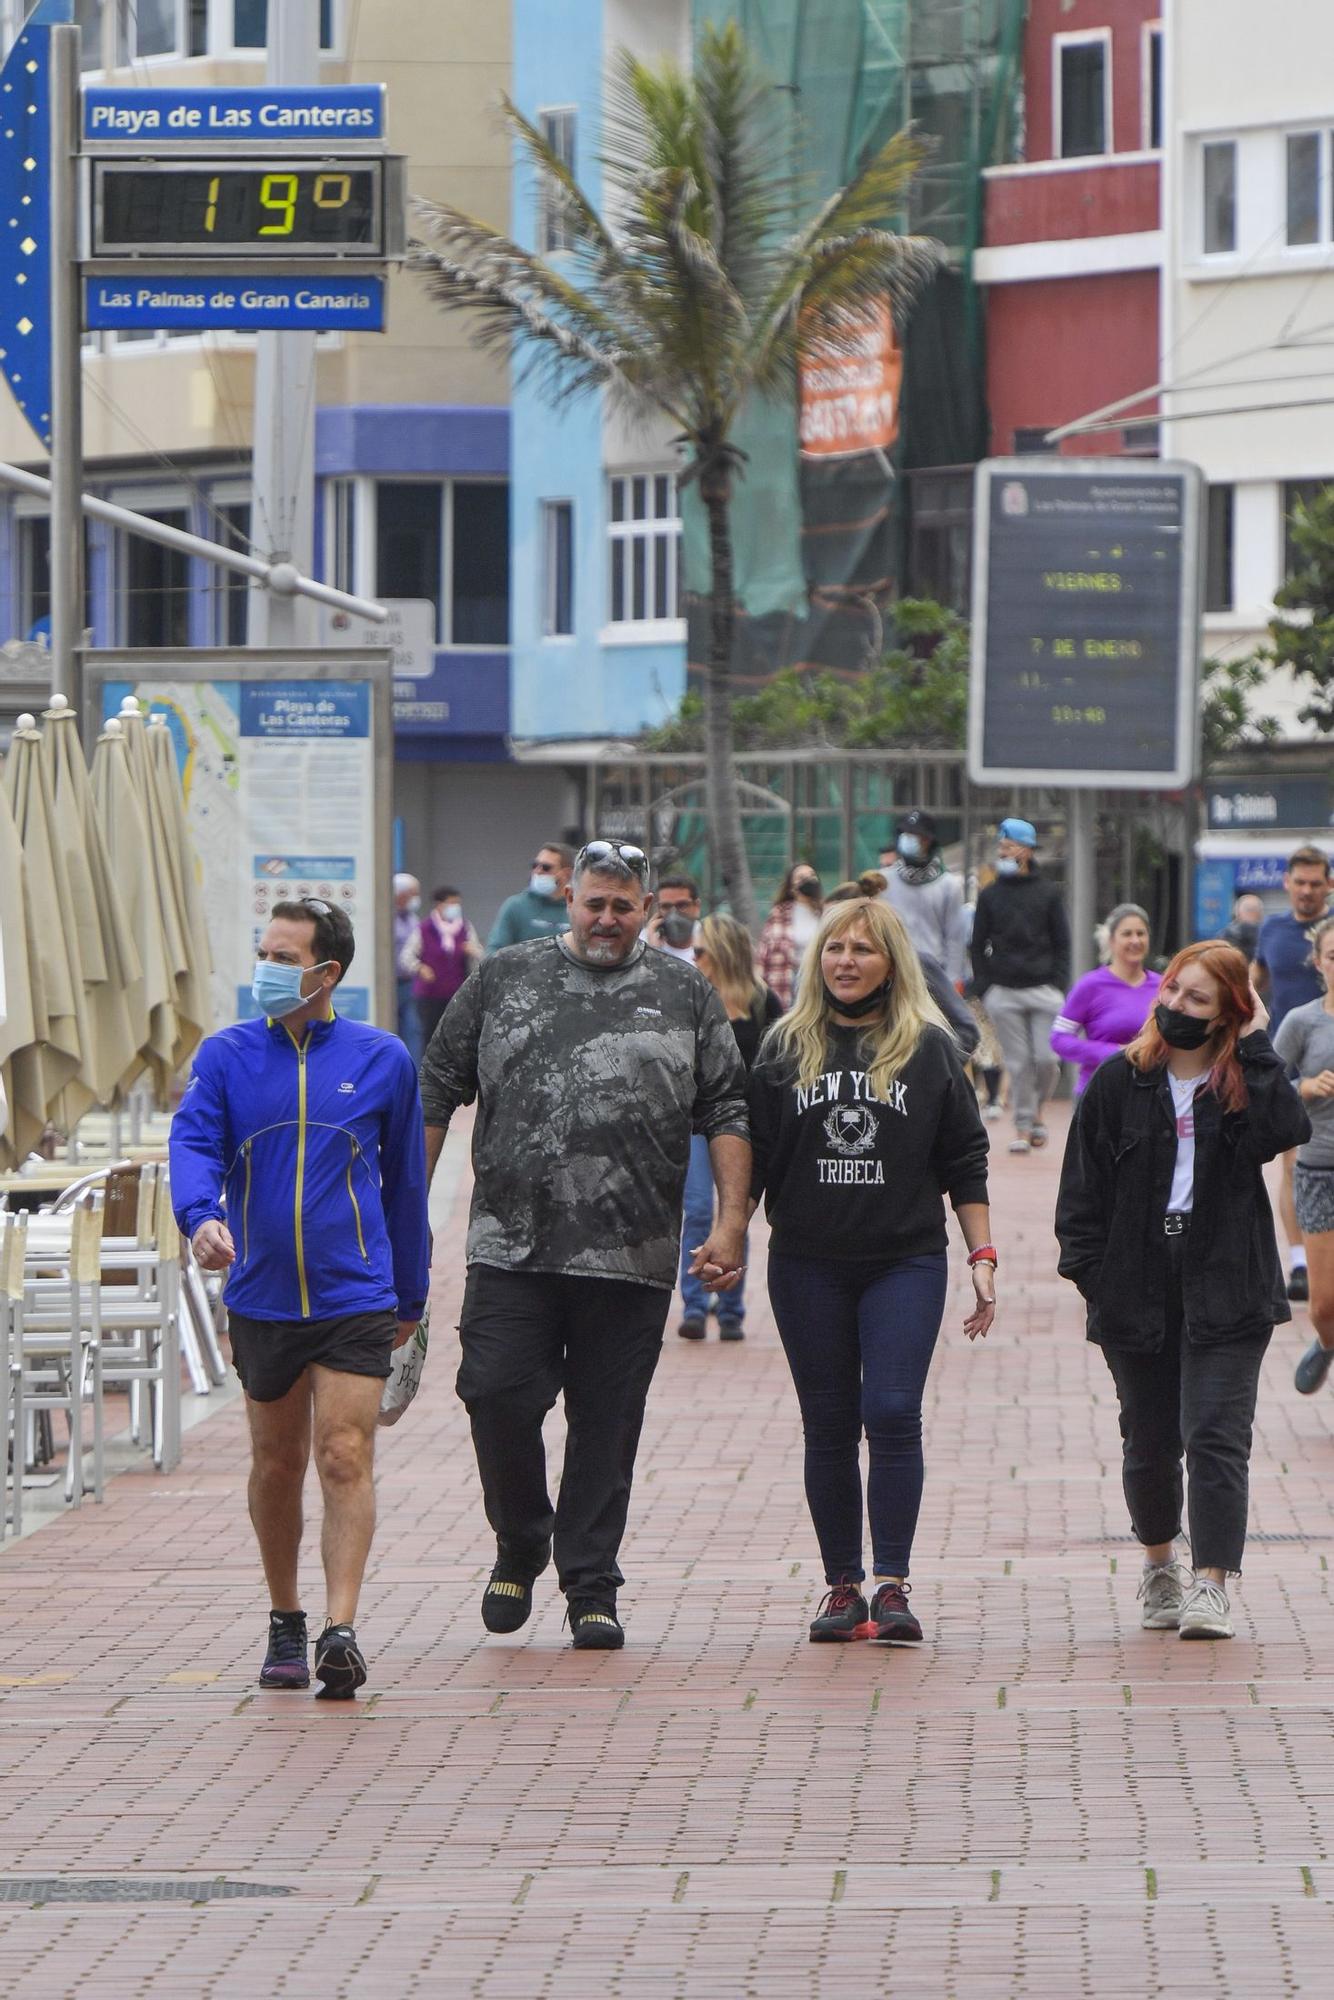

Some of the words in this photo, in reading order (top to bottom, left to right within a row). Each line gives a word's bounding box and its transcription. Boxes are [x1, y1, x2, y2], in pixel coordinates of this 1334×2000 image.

[92, 106, 160, 134] Playa
[167, 105, 202, 127] de
[208, 105, 252, 127] Las
[259, 104, 374, 127] Canteras
[100, 290, 132, 307] Las
[137, 290, 205, 308] Palmas
[209, 292, 235, 308] de
[240, 291, 289, 308] Gran
[295, 291, 370, 308] Canaria
[274, 699, 315, 715] Playa
[315, 699, 336, 713] de
[258, 712, 285, 726] Las
[287, 712, 351, 727] Canteras
[797, 1071, 842, 1115] NEW
[817, 1159, 885, 1184] TRIBECA
